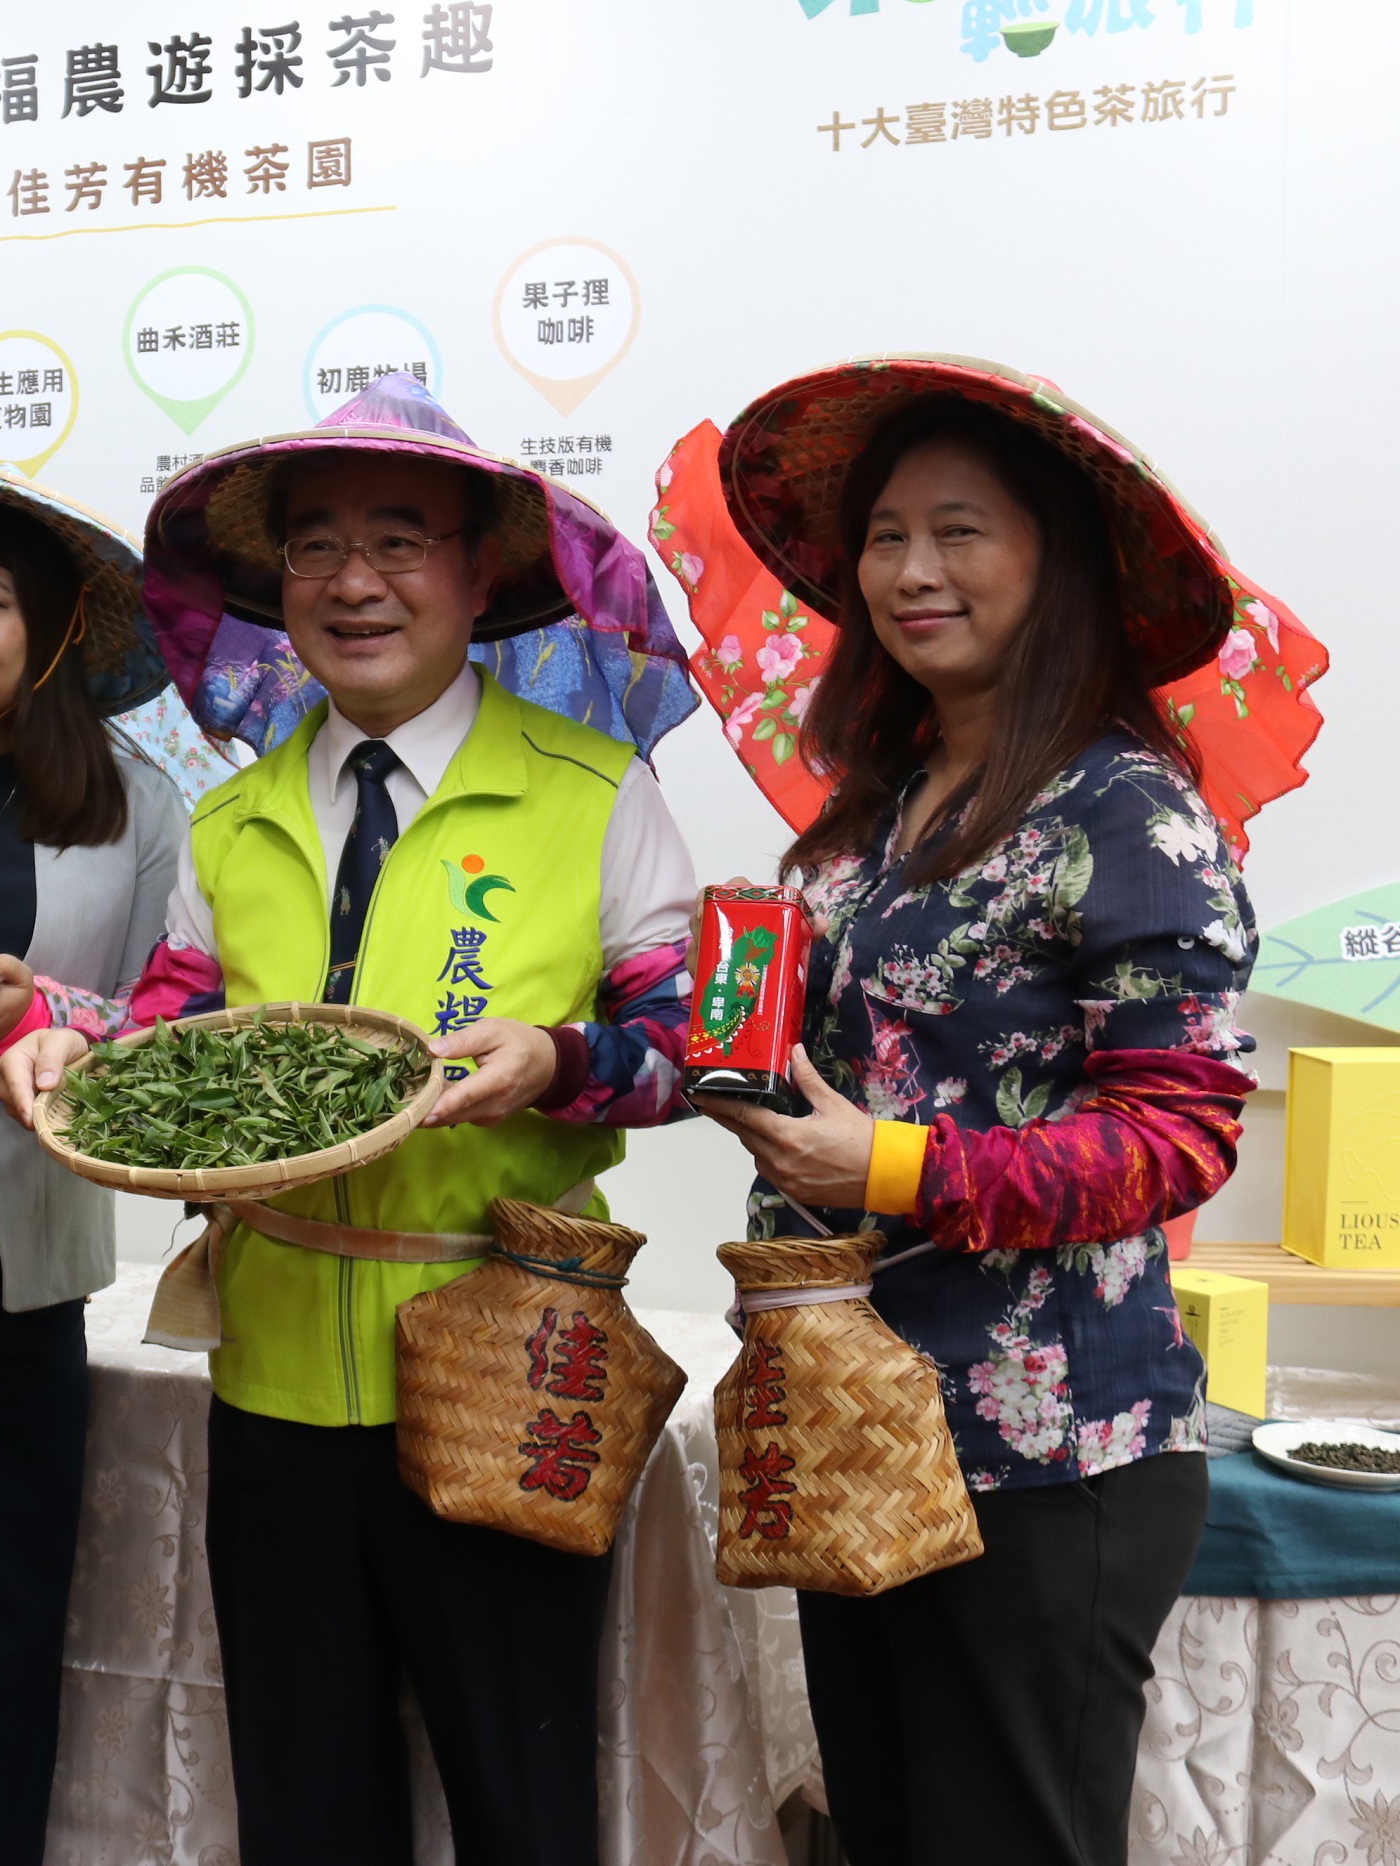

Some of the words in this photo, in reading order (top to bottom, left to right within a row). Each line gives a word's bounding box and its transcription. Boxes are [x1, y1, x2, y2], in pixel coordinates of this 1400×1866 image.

[815, 74, 1237, 152] 十大臺灣特色茶旅行
[6, 137, 353, 217] 佳芳有機茶園
[522, 278, 610, 310] 果子狸
[136, 321, 241, 354] 曲禾酒莊
[536, 315, 595, 345] 咖啡
[519, 434, 612, 455] 生技版有機
[429, 926, 494, 1082] 農糧
[1338, 1233, 1382, 1249] TEA
[518, 1307, 609, 1502] 佳芳
